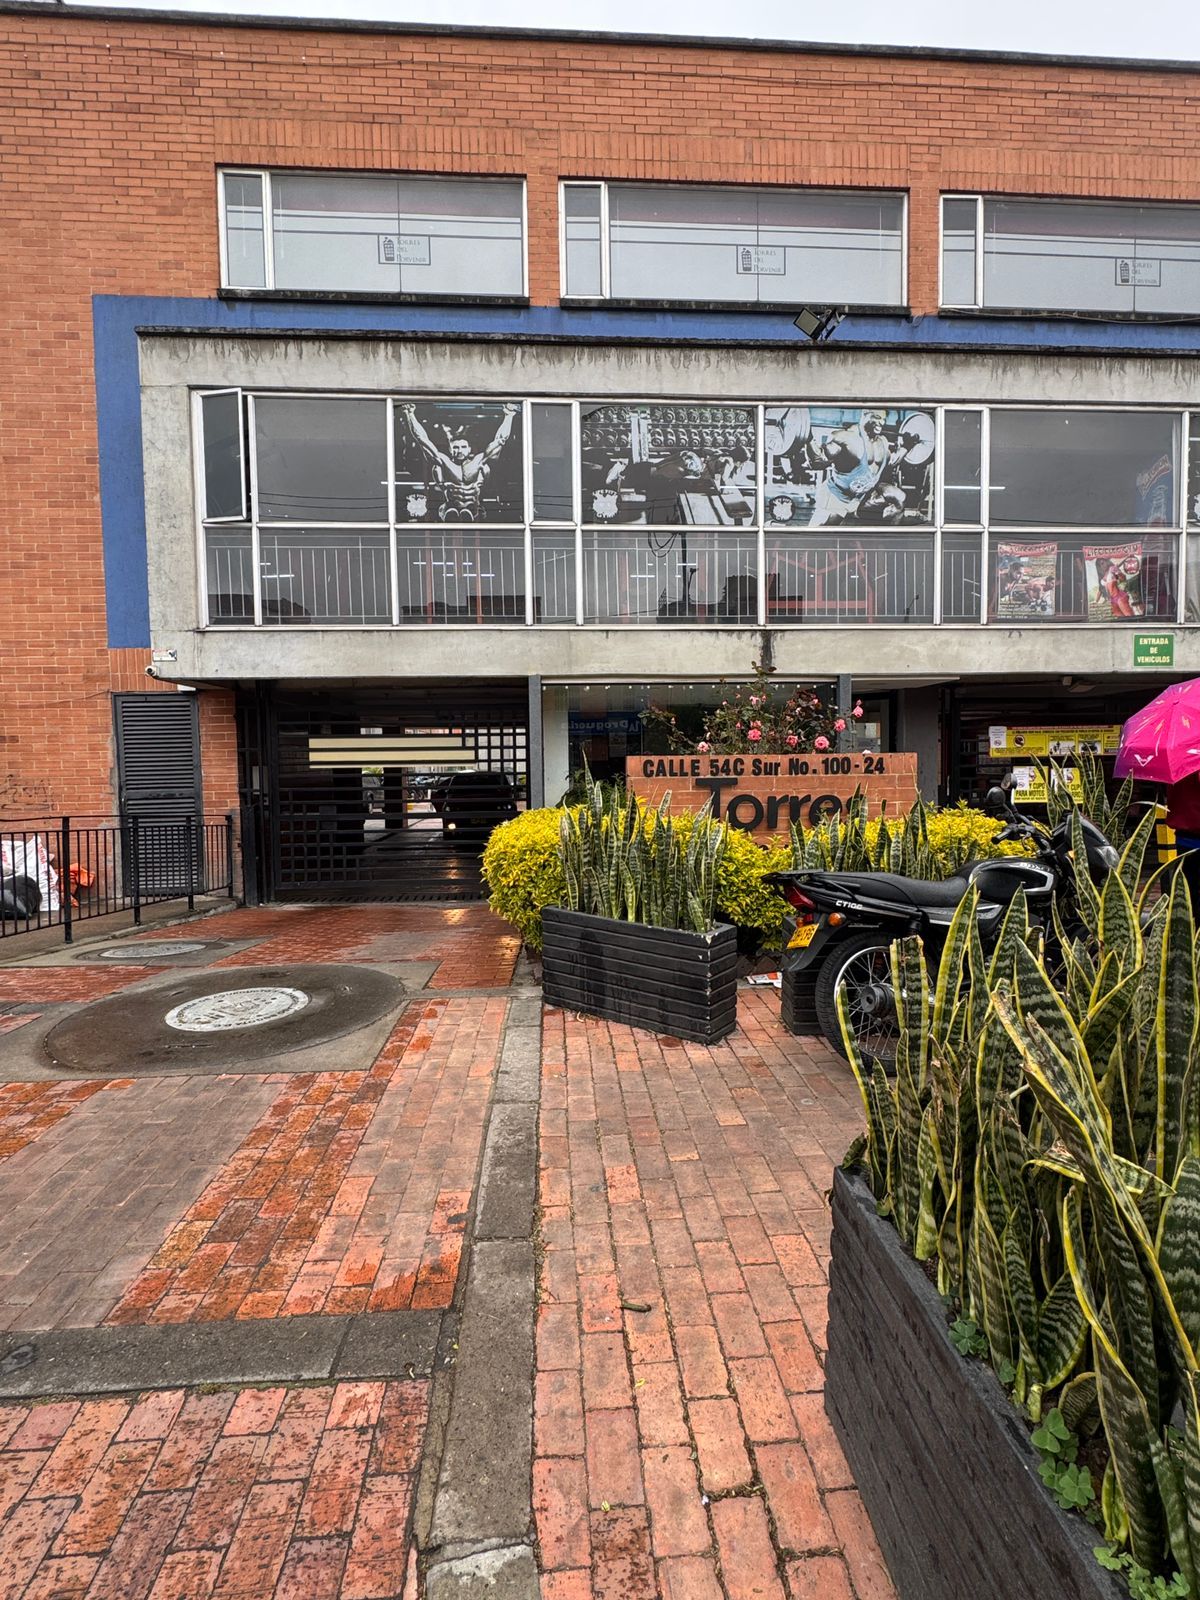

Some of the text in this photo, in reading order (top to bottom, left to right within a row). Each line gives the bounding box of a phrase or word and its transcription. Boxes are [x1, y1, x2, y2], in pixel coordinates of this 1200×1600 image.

[643, 759, 701, 777] CALLE
[710, 758, 745, 776] 54C
[752, 758, 781, 776] Sur
